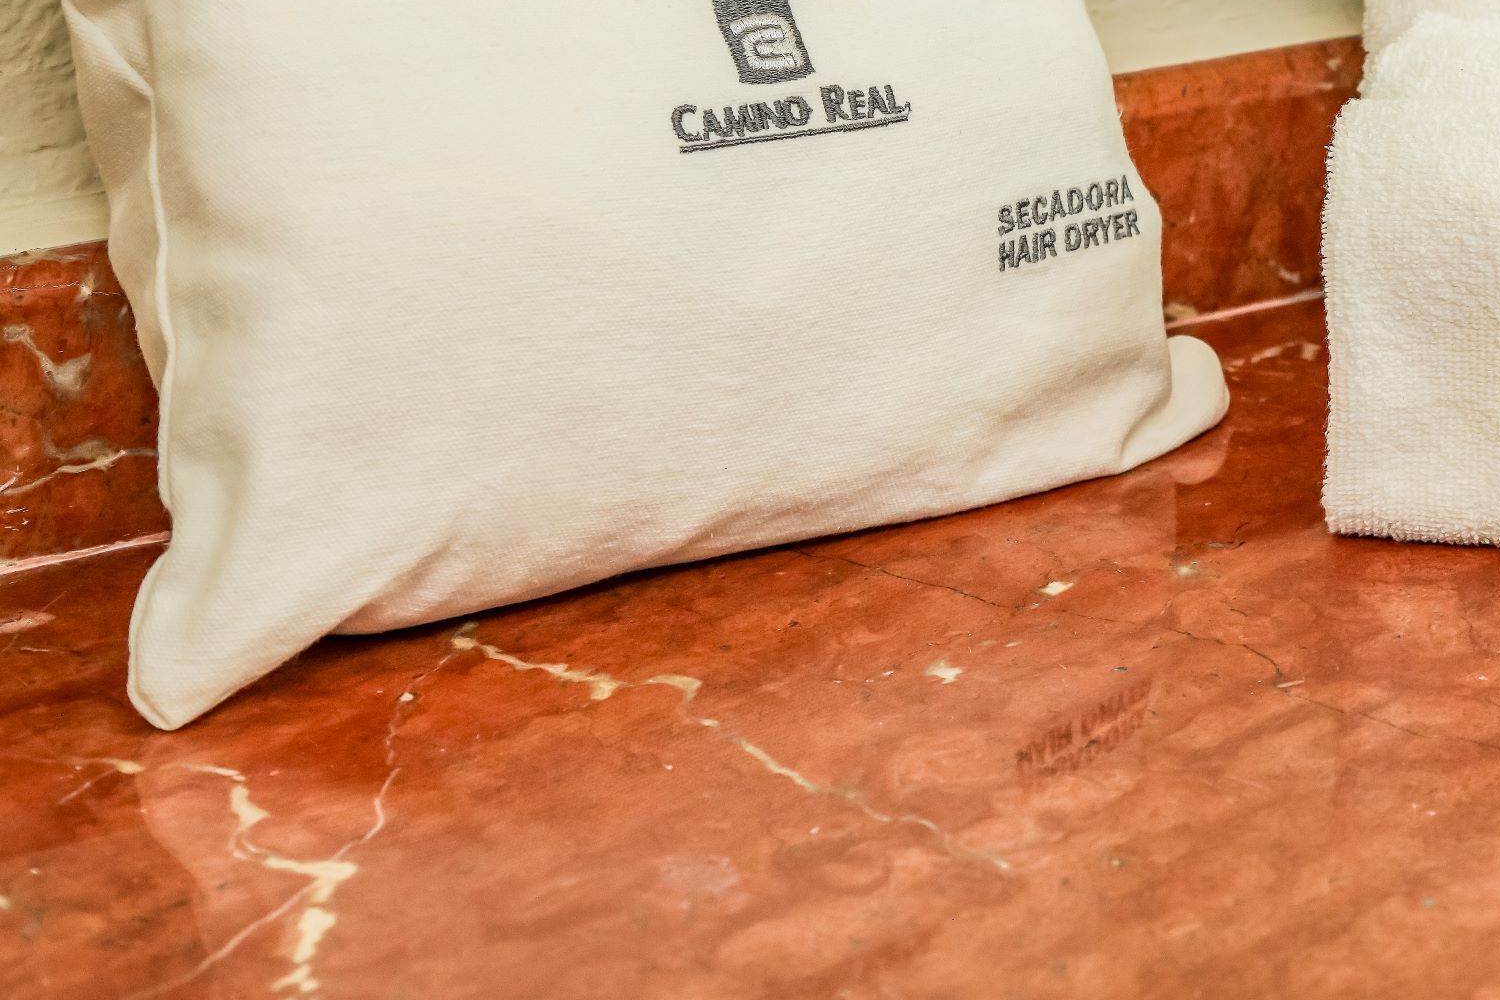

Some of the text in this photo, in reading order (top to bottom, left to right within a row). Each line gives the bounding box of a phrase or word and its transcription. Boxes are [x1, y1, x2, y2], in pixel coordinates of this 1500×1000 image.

[670, 84, 911, 142] CAMINO REAL
[998, 174, 1134, 236] SECADORA
[998, 208, 1140, 272] HAIR DRYER
